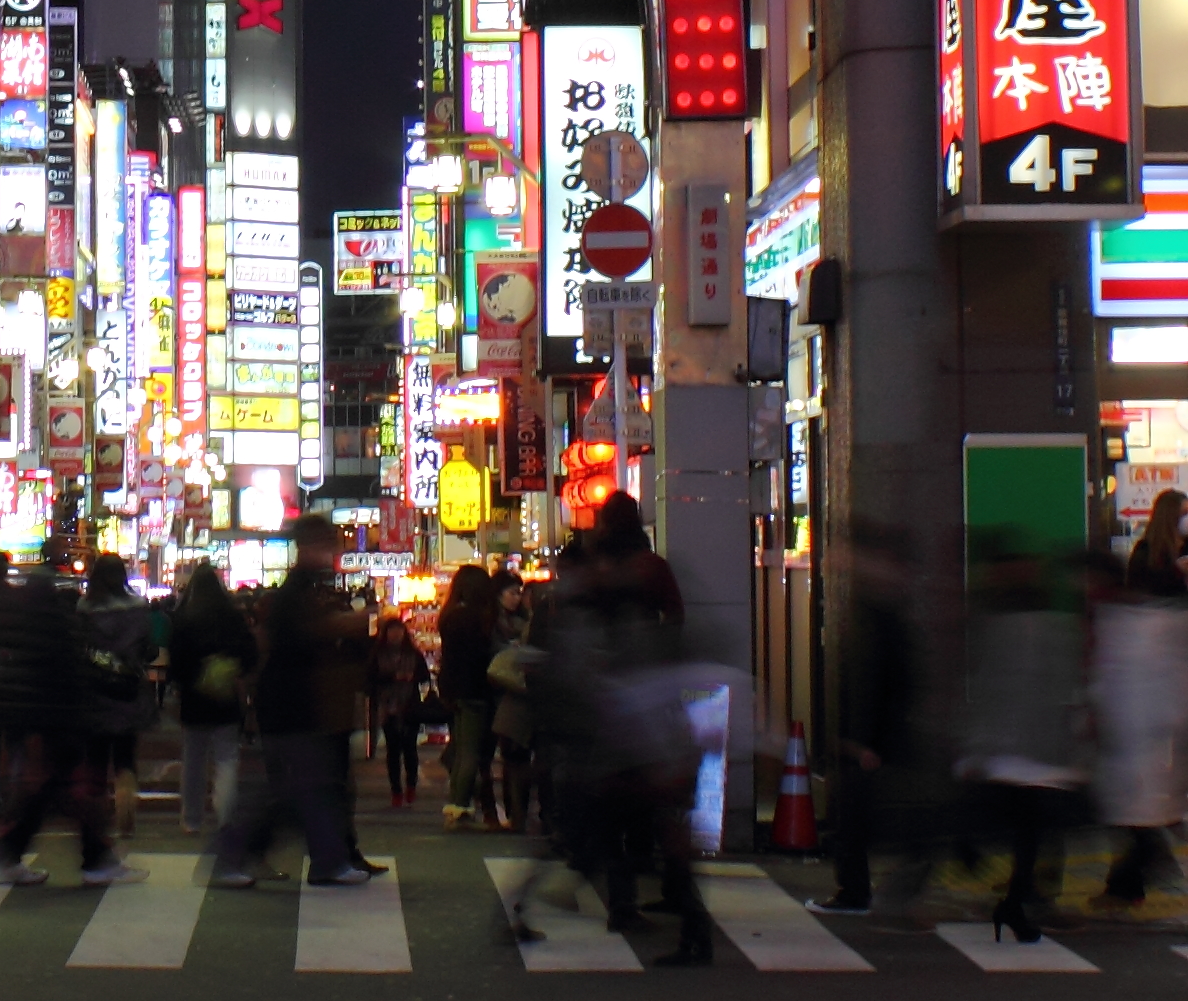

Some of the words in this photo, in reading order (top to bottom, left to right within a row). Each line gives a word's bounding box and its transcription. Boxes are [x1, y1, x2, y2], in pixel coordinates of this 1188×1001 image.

[1008, 135, 1099, 193] 4F
[700, 207, 718, 299] 劇場通り
